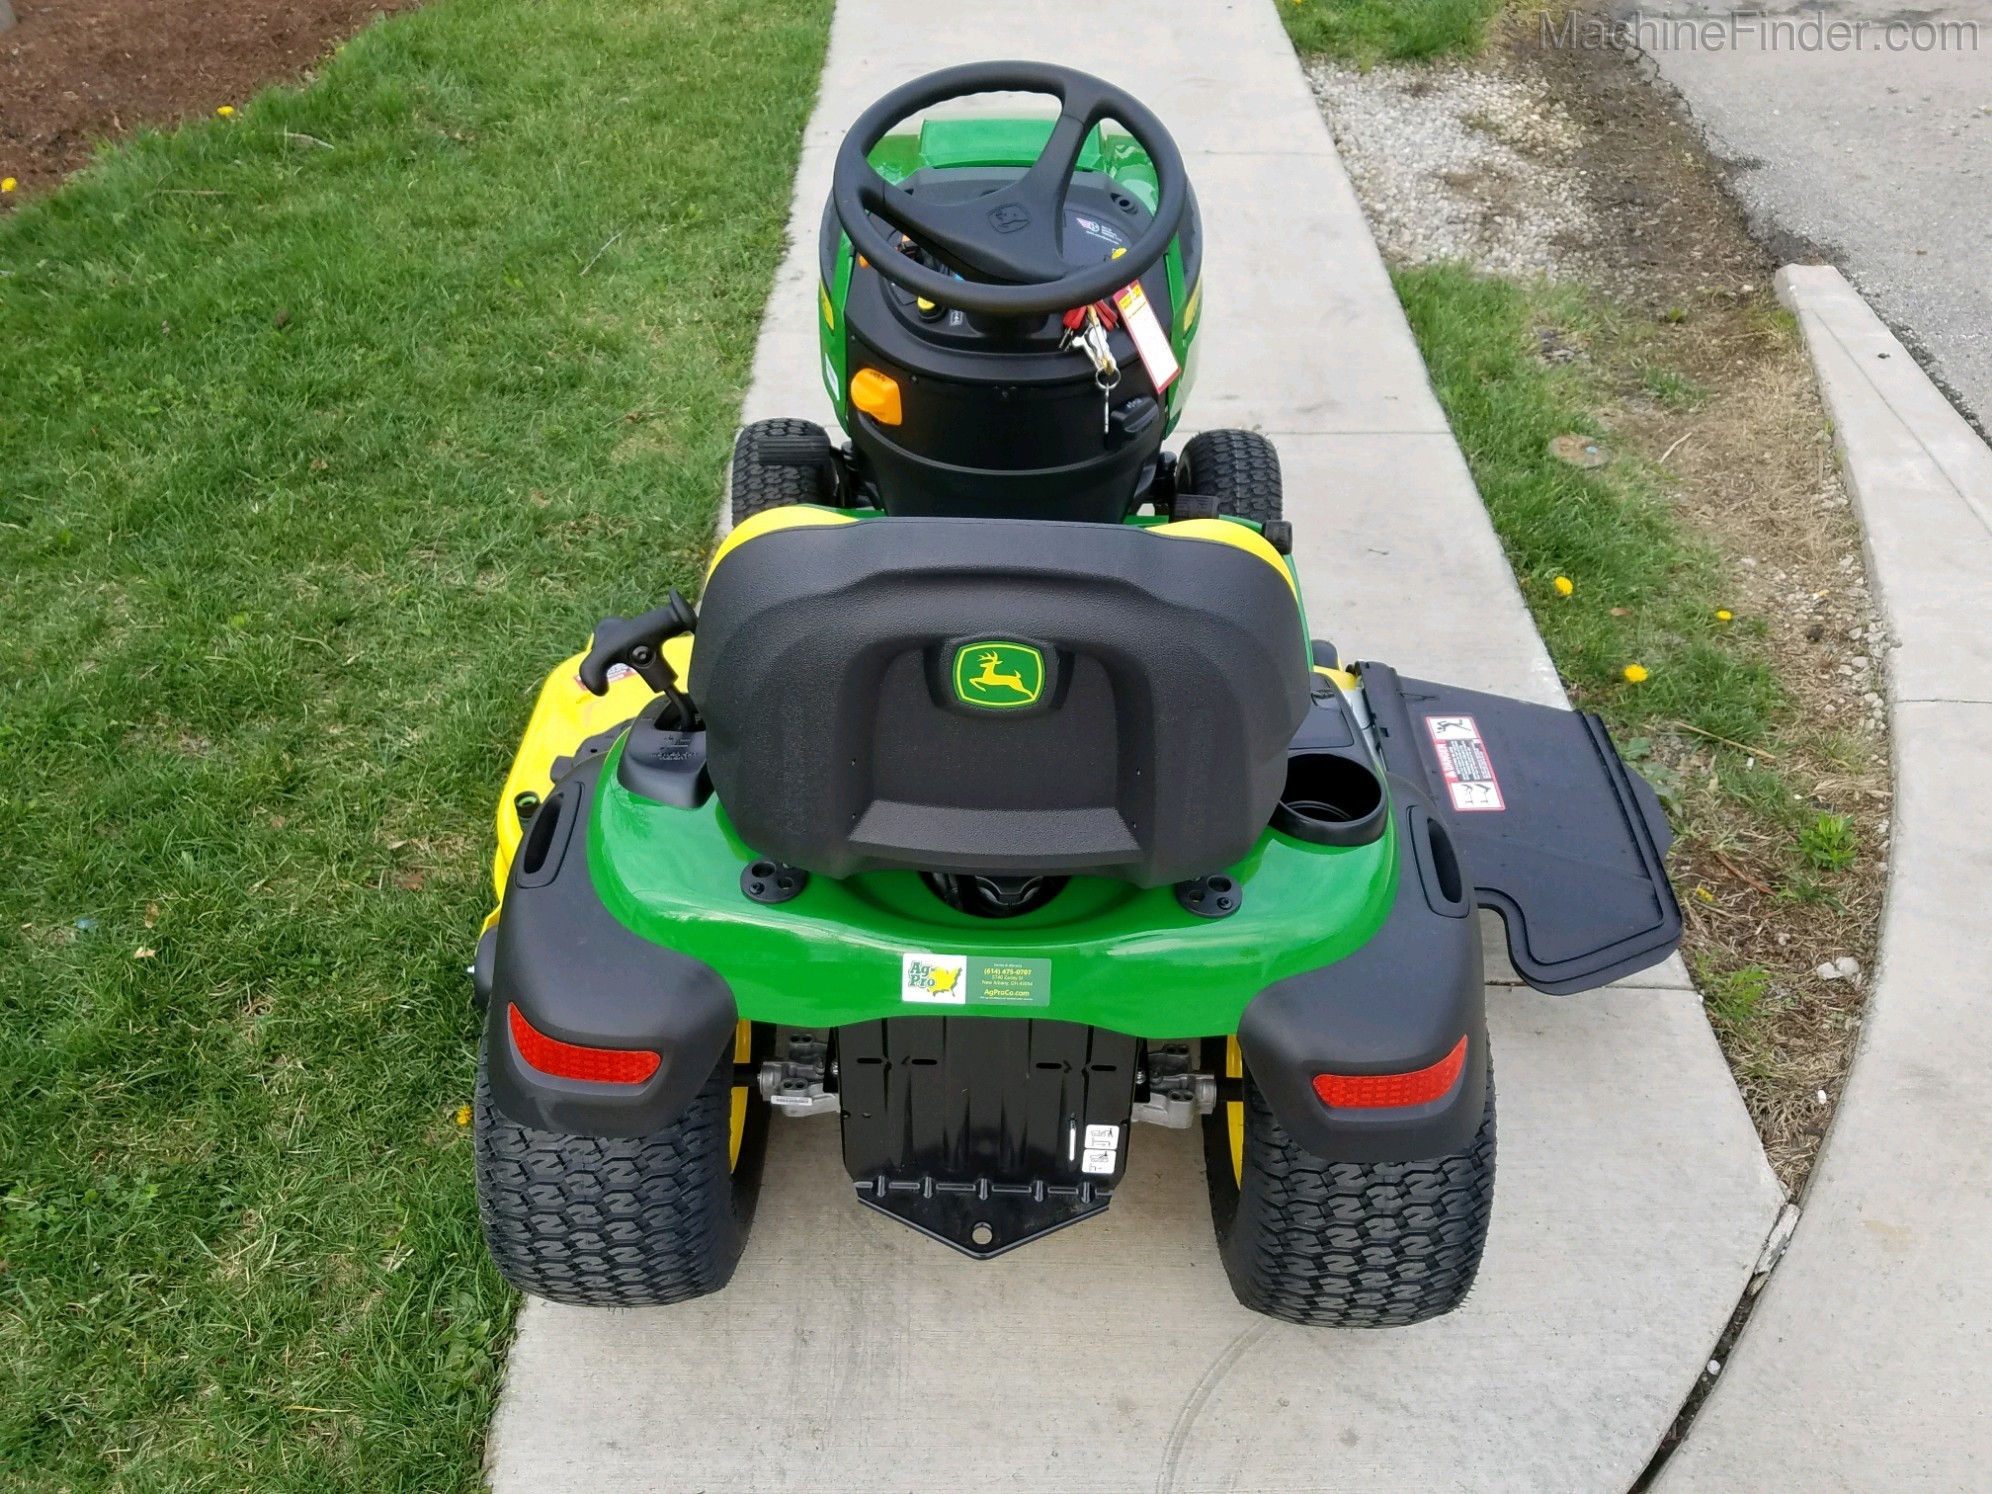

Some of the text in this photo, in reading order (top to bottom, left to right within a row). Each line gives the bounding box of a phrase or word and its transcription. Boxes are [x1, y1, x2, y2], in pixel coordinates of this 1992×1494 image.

[983, 967, 1001, 975] (614)
[909, 974, 936, 987] Pro
[983, 988, 1030, 997] AgProCo.com
